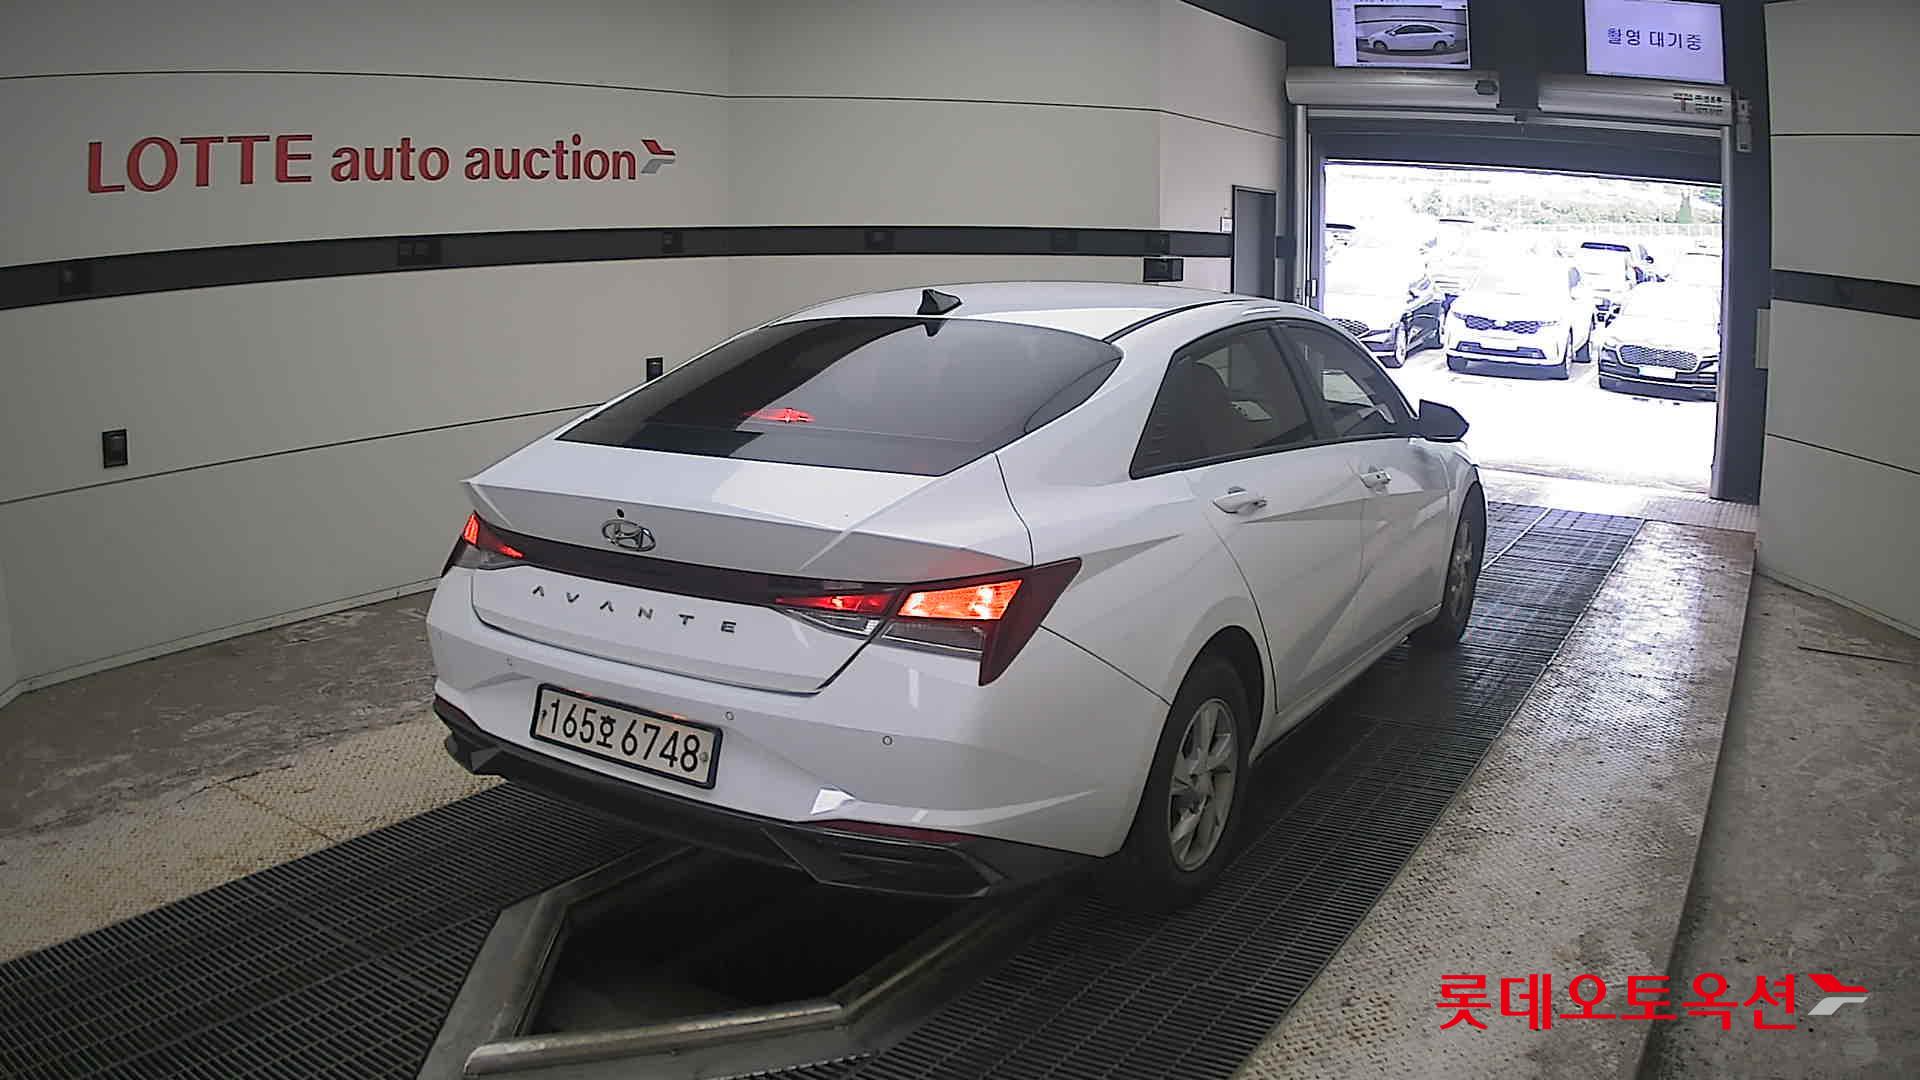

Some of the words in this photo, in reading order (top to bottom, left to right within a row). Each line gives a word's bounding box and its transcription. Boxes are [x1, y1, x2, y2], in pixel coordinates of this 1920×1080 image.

[1648, 28, 1702, 51] 대기중
[88, 134, 312, 193] LOTTE
[331, 137, 450, 182] auto
[465, 134, 637, 181] auction
[532, 585, 736, 633] AVANTE
